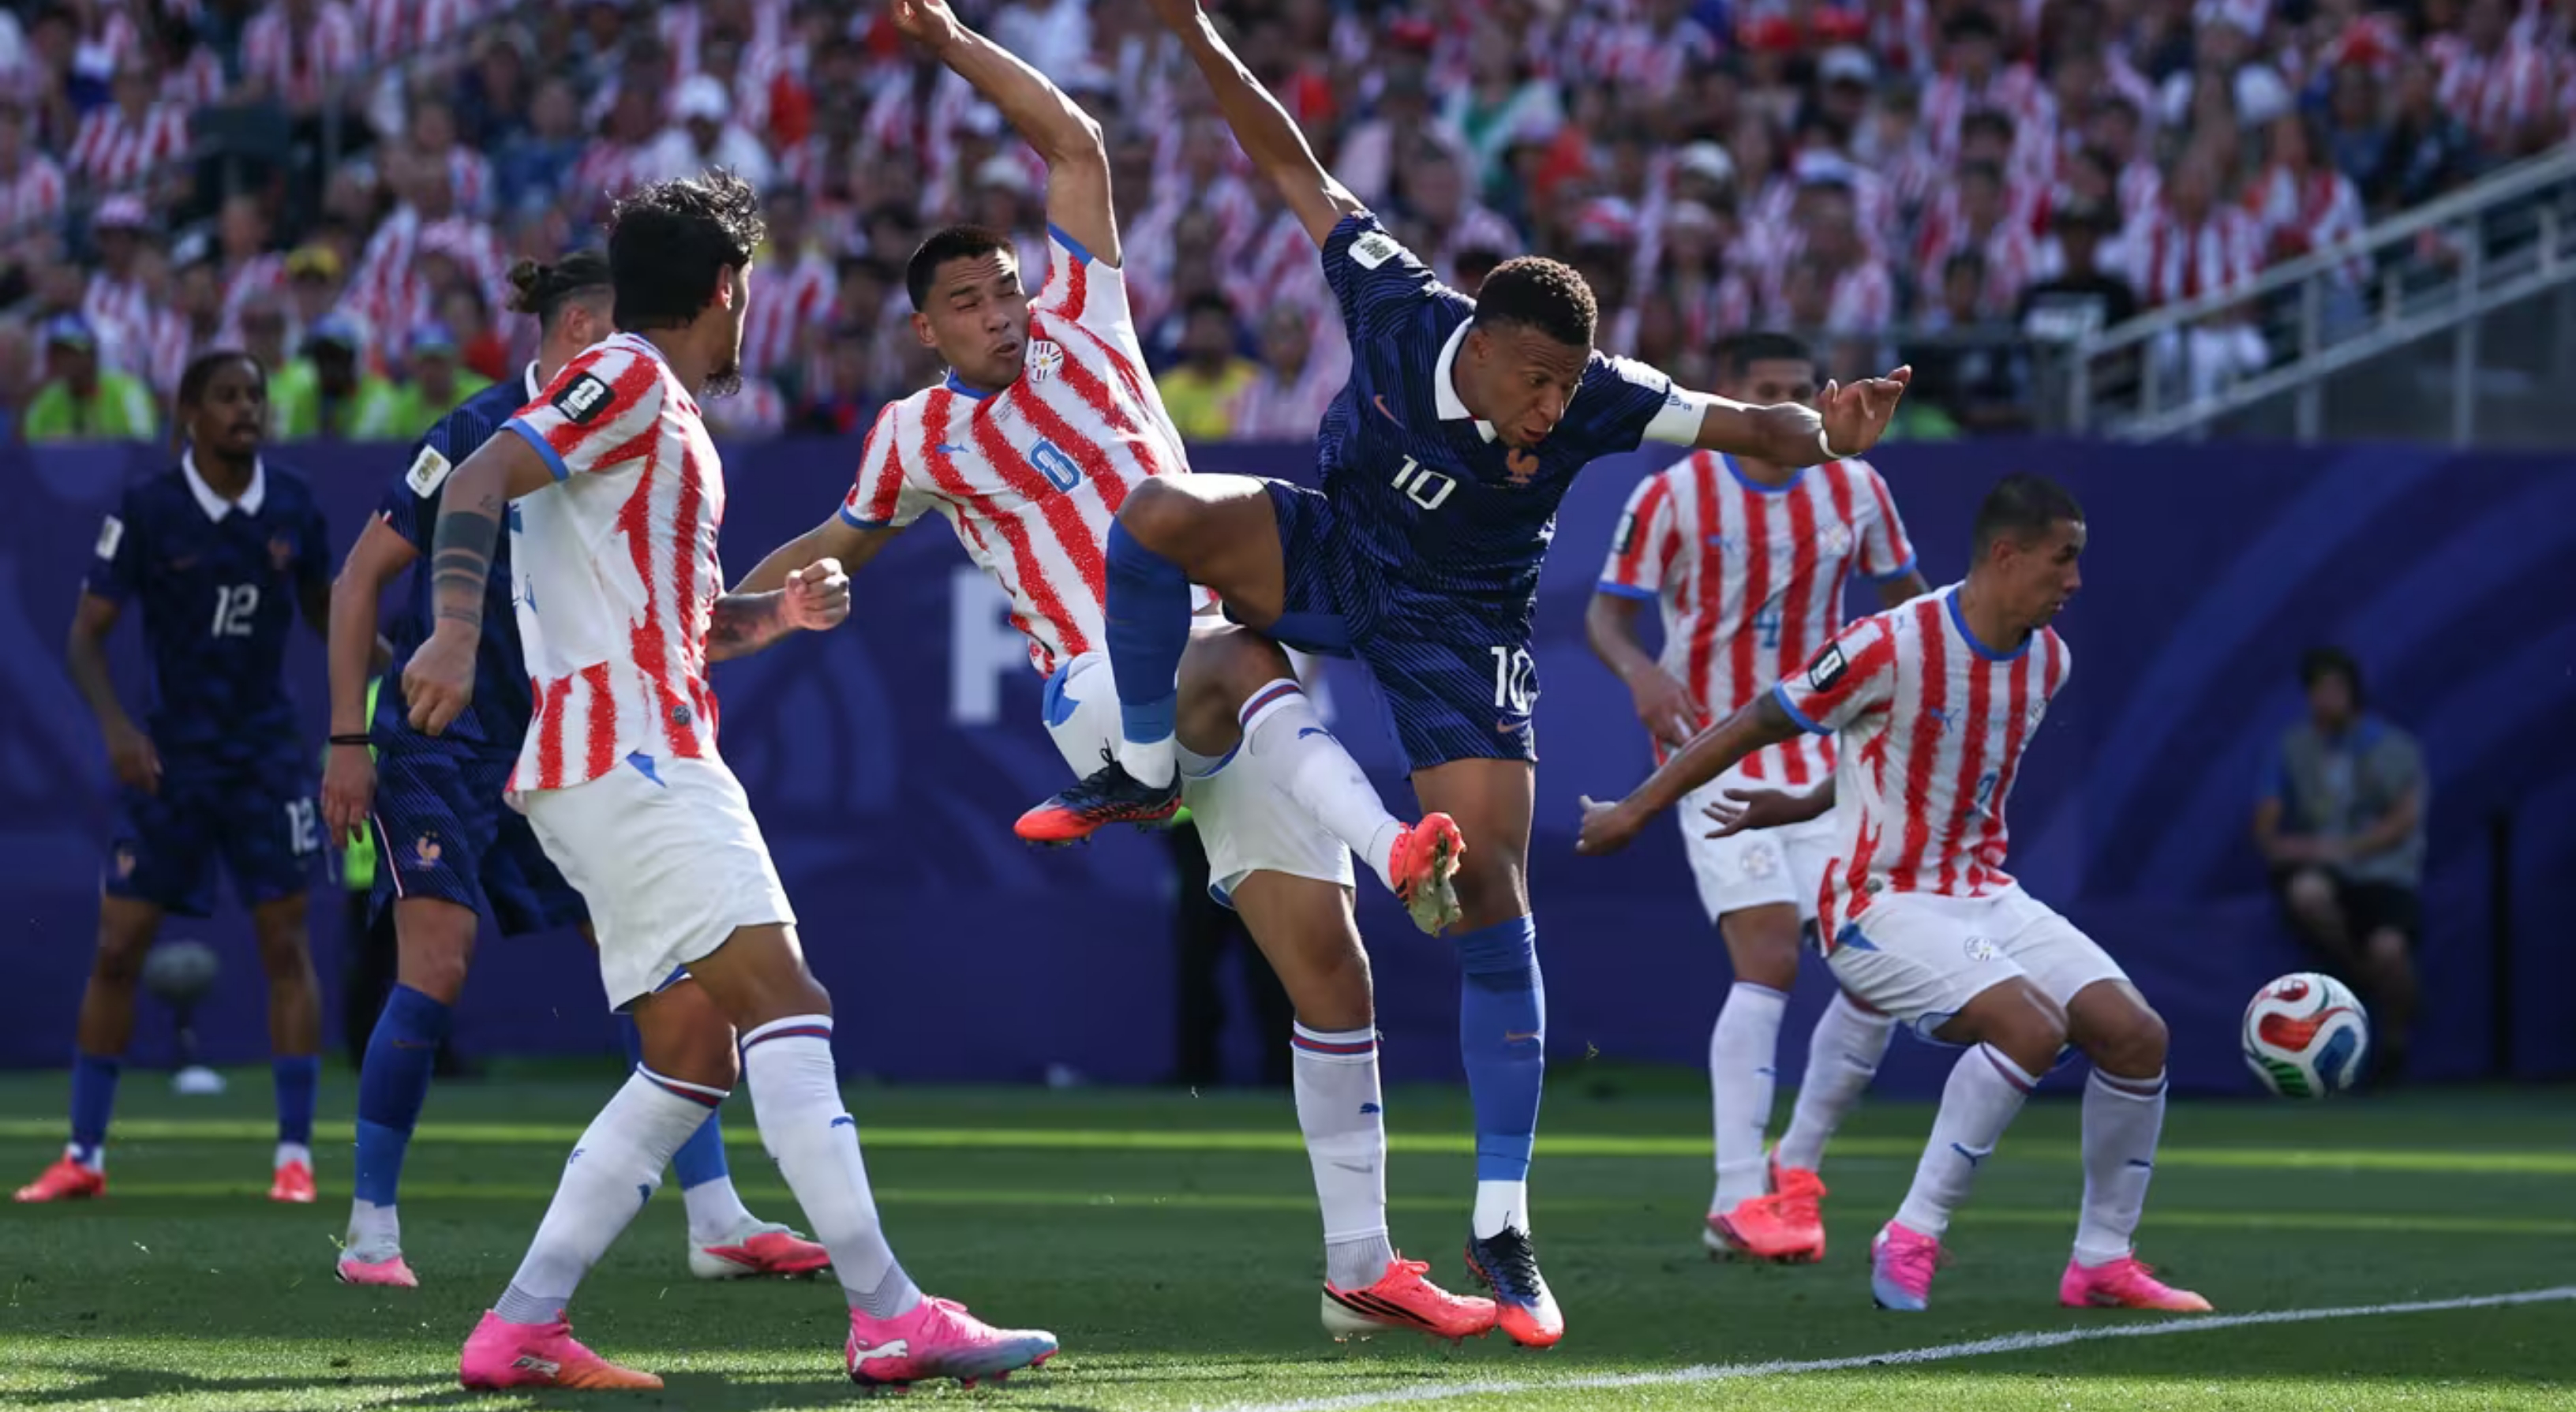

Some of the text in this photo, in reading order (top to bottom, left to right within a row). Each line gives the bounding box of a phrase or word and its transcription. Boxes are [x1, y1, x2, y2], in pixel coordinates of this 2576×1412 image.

[1391, 454, 1457, 510] 10
[212, 582, 259, 638] 12
[1753, 597, 1781, 648] 4
[1491, 646, 1535, 713] 10
[285, 797, 319, 856] 12
